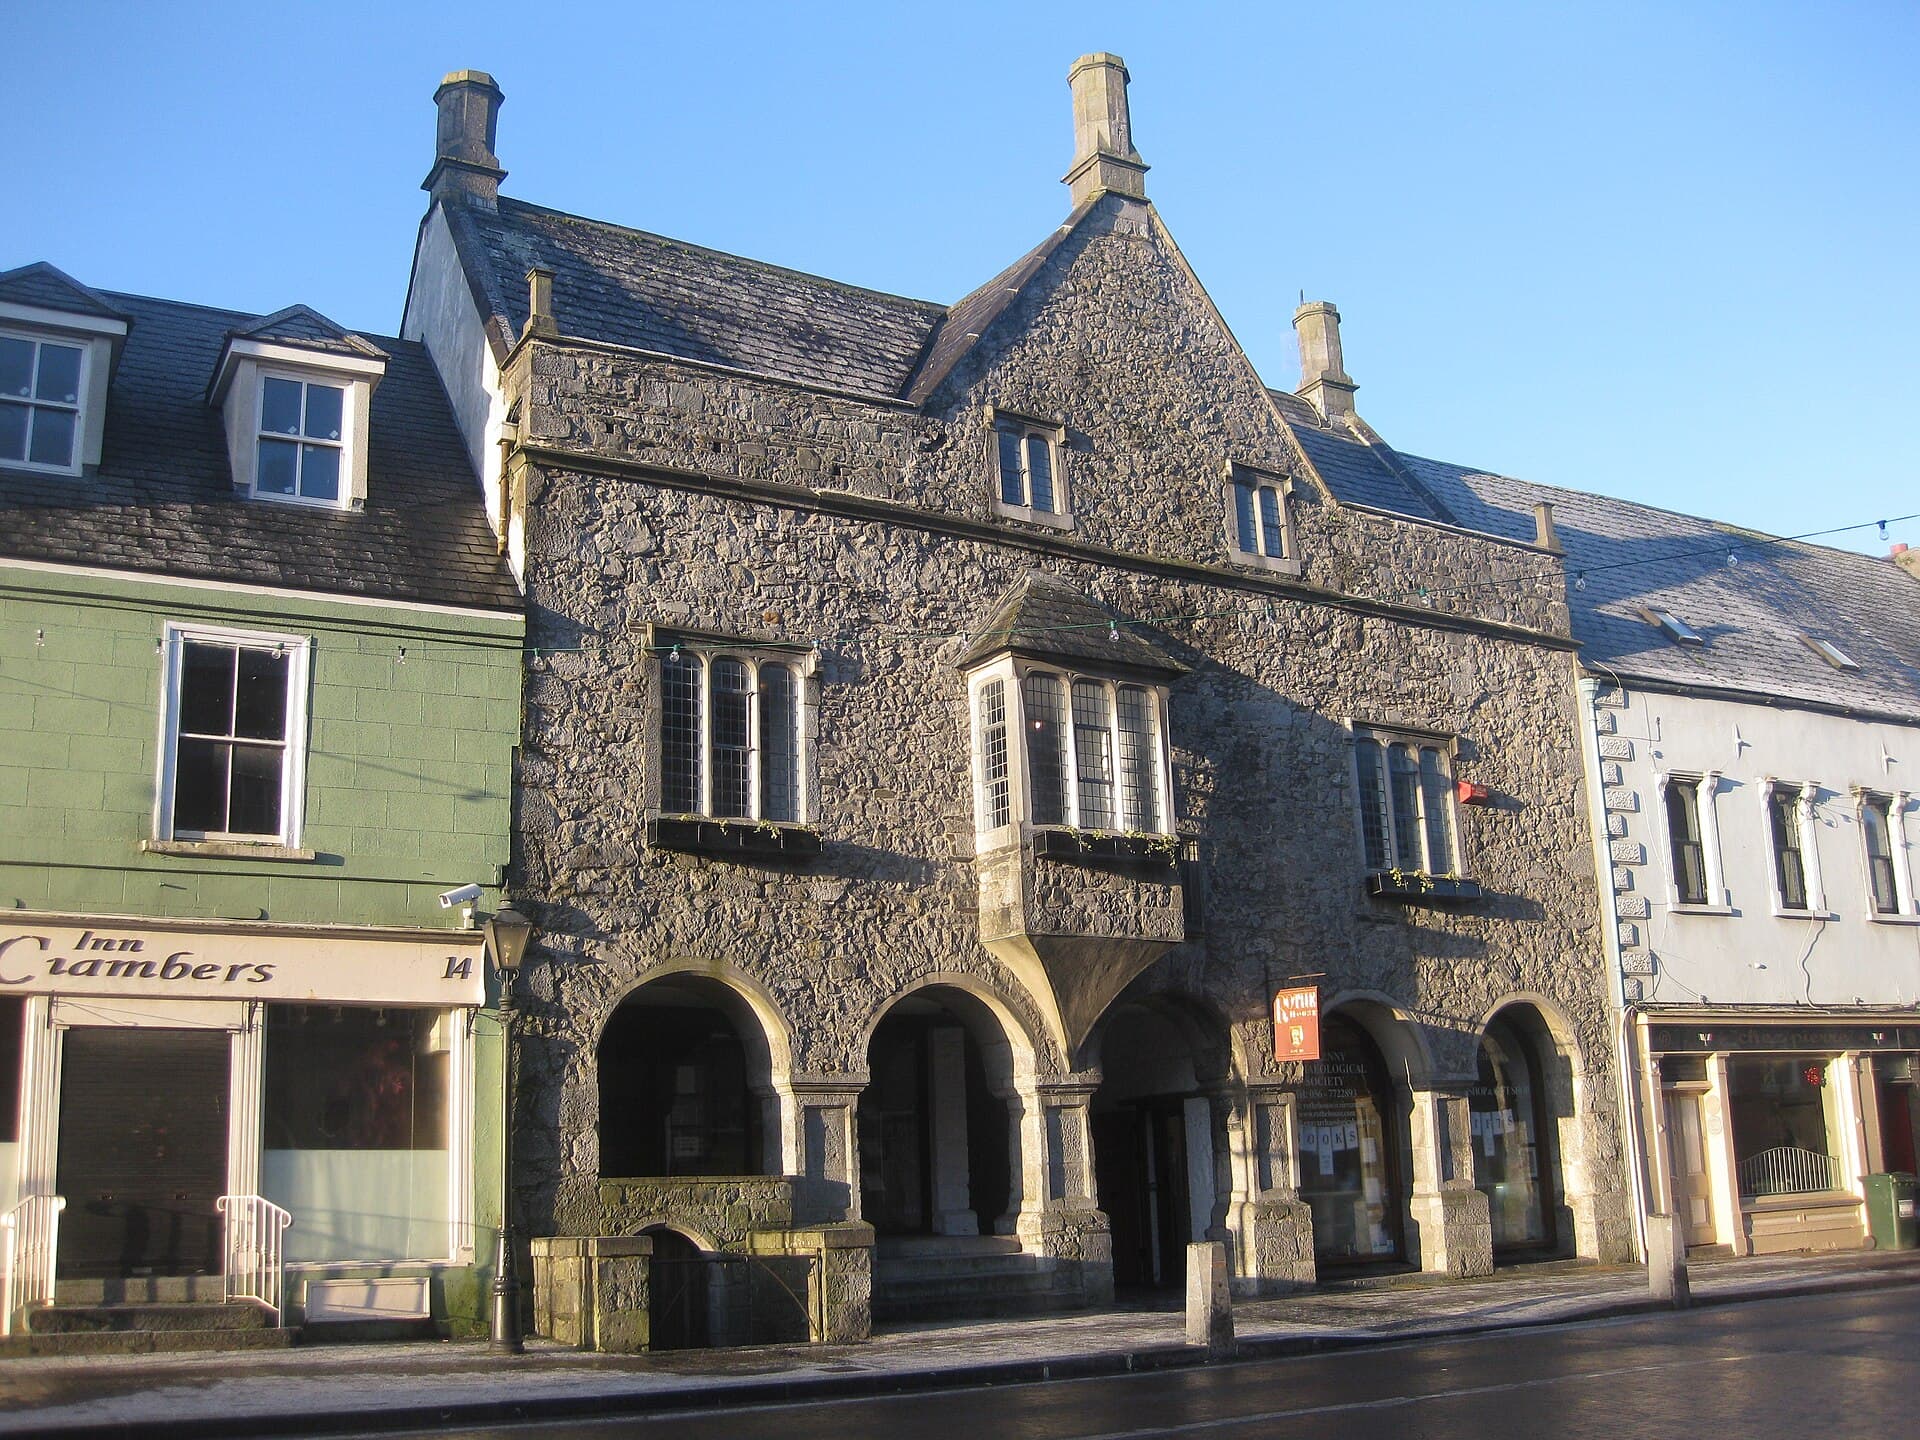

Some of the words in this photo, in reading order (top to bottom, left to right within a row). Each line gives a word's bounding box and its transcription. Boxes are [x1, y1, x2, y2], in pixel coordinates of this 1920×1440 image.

[74, 930, 145, 953] Inn
[440, 956, 473, 980] 14
[1474, 1115, 1513, 1129] IFTS
